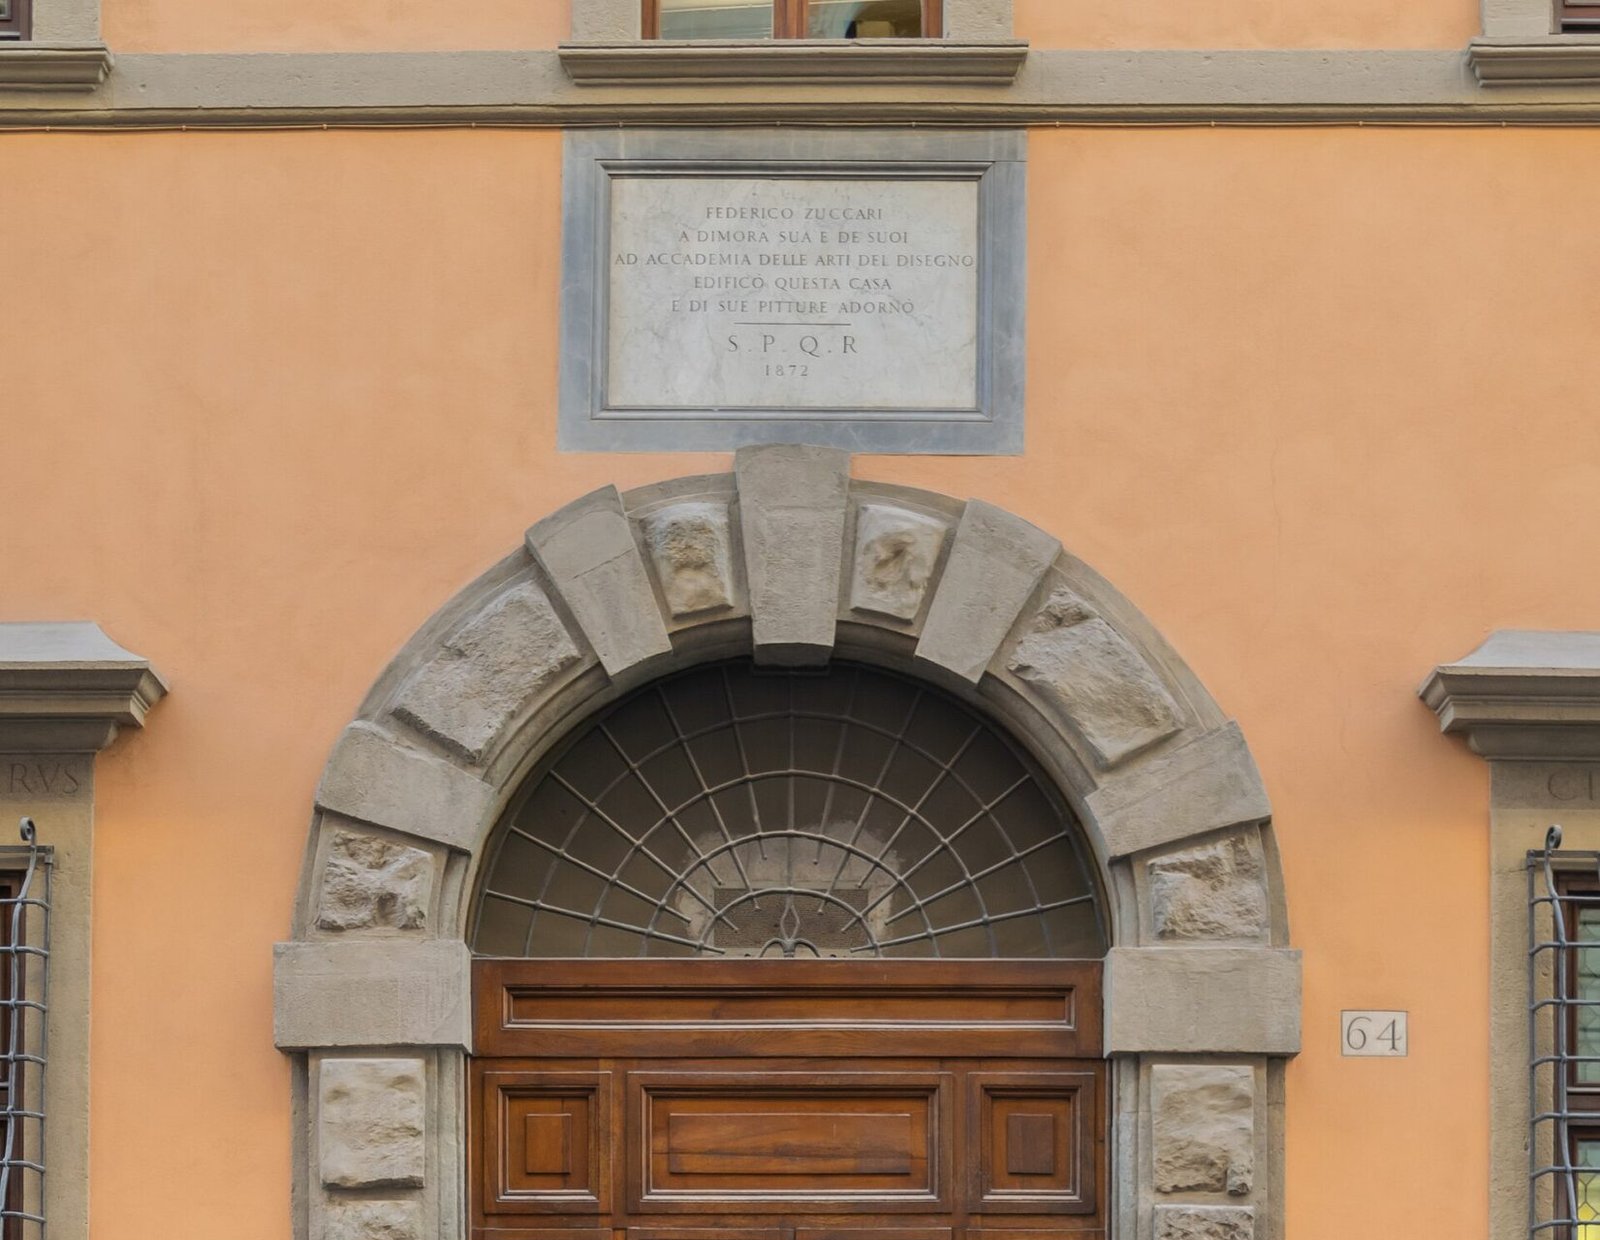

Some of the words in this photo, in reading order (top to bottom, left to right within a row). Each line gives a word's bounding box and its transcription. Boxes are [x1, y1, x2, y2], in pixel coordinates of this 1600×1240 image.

[706, 207, 794, 220] FEDERICO
[804, 208, 883, 220] ZUCCARI
[678, 231, 690, 243] A
[697, 230, 769, 243] DIMORA
[779, 231, 812, 243] SUA
[820, 231, 828, 243] E
[868, 231, 908, 243] SUOI
[614, 253, 638, 265] AD
[647, 253, 752, 266] ACCADEMIA
[759, 254, 808, 266] DELLE
[815, 254, 850, 266] ARTI
[858, 254, 889, 267] DEL
[896, 255, 974, 267] DISEGNO
[775, 277, 840, 291] QUESTA
[849, 277, 892, 290] CASA
[672, 300, 680, 312] E
[689, 300, 707, 312] DI
[719, 300, 749, 313] SUE
[759, 301, 828, 313] PITTURE
[765, 364, 808, 377] 1872
[1346, 1016, 1403, 1051] 64
